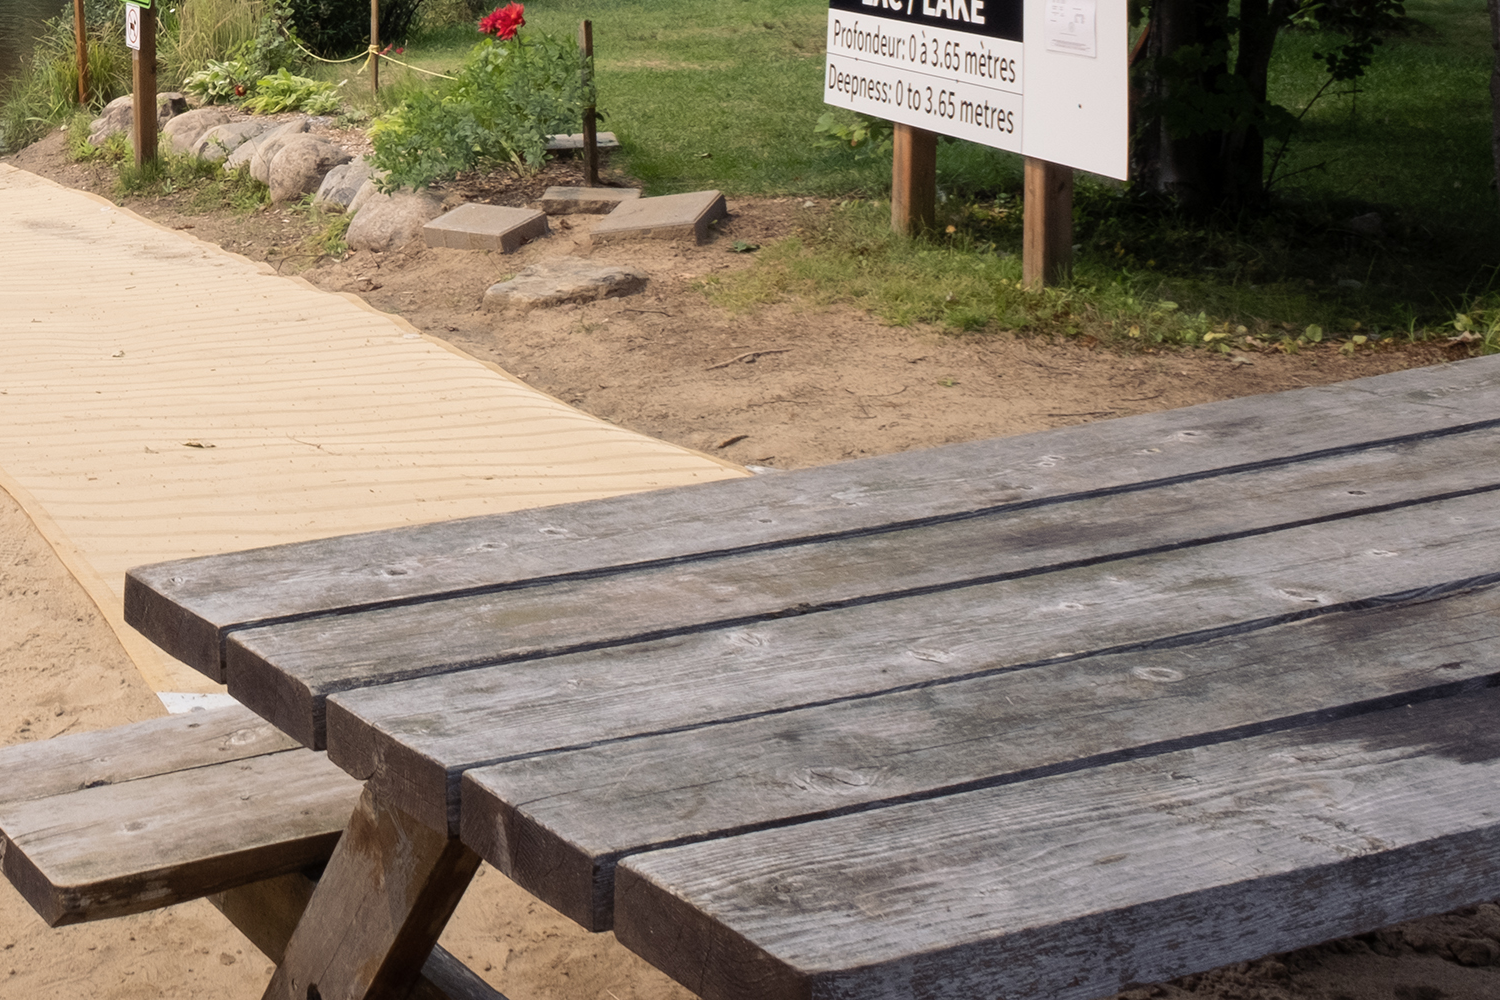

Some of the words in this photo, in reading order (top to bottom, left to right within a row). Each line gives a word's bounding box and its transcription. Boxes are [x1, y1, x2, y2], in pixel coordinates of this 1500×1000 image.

[833, 18, 905, 60] Profondeur:
[909, 34, 916, 62] 0
[920, 30, 927, 64] à
[931, 38, 960, 71] 3.65
[964, 41, 1016, 83] mètres
[828, 63, 892, 103] Deepness:
[895, 80, 903, 106] 0
[907, 82, 920, 111] to
[925, 86, 955, 119] 3.65
[960, 99, 1014, 134] metres
